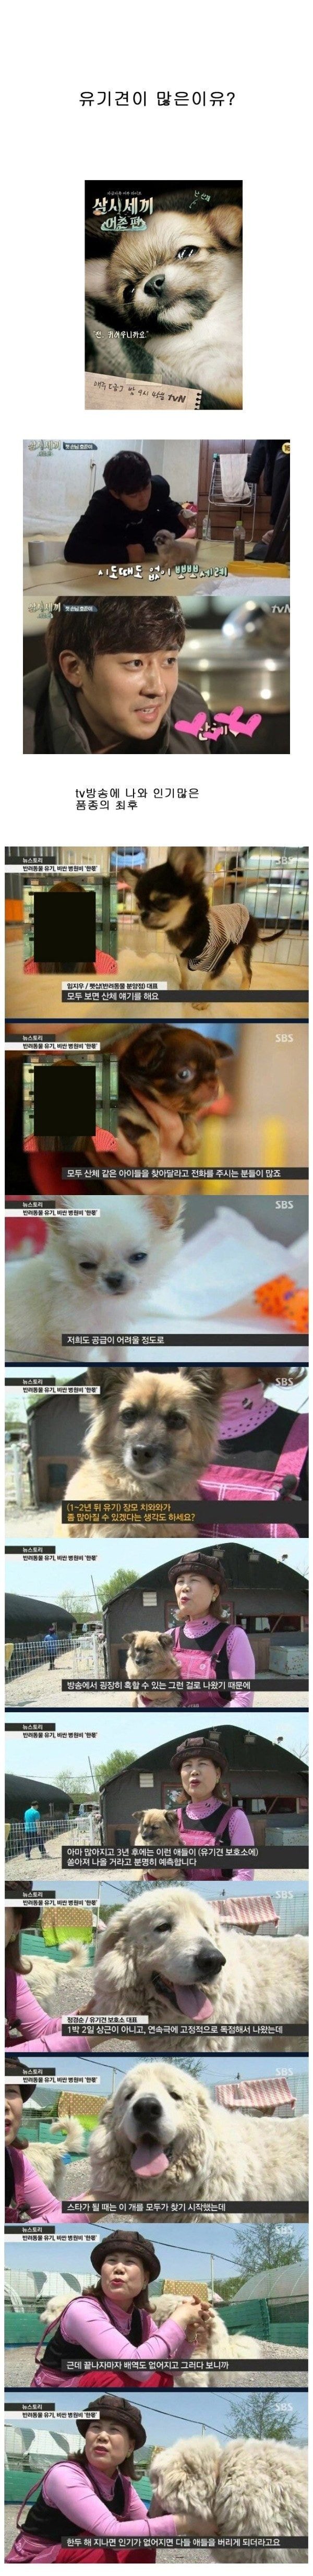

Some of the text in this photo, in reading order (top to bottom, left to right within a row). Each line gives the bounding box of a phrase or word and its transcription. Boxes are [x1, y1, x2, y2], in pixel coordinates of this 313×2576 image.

[92, 196, 153, 216] 삼시세끼
[93, 380, 106, 391] 매주
[167, 394, 186, 403] tvN
